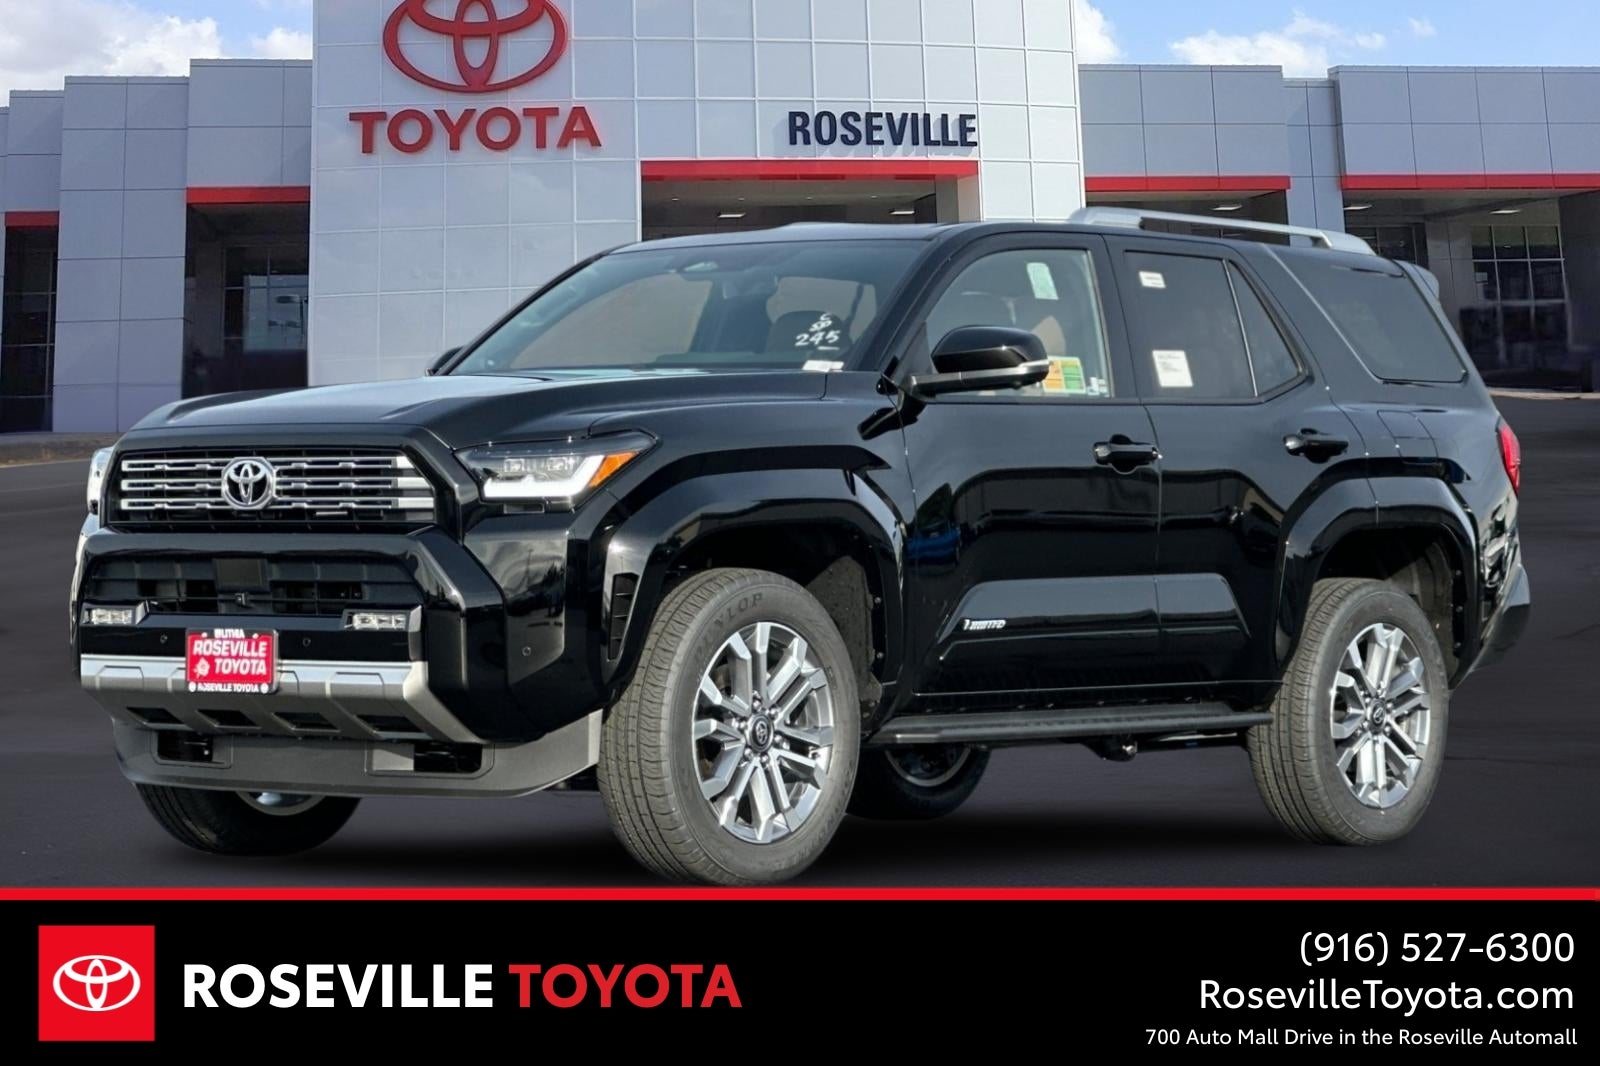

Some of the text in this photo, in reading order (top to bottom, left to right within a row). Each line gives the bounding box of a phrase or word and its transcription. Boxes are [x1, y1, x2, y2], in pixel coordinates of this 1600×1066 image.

[350, 106, 602, 154] TOYOTA
[788, 110, 978, 148] ROSEVILLE
[794, 330, 841, 346] 245
[192, 639, 268, 657] ROSEVILLE
[214, 658, 267, 676] TOYOTA
